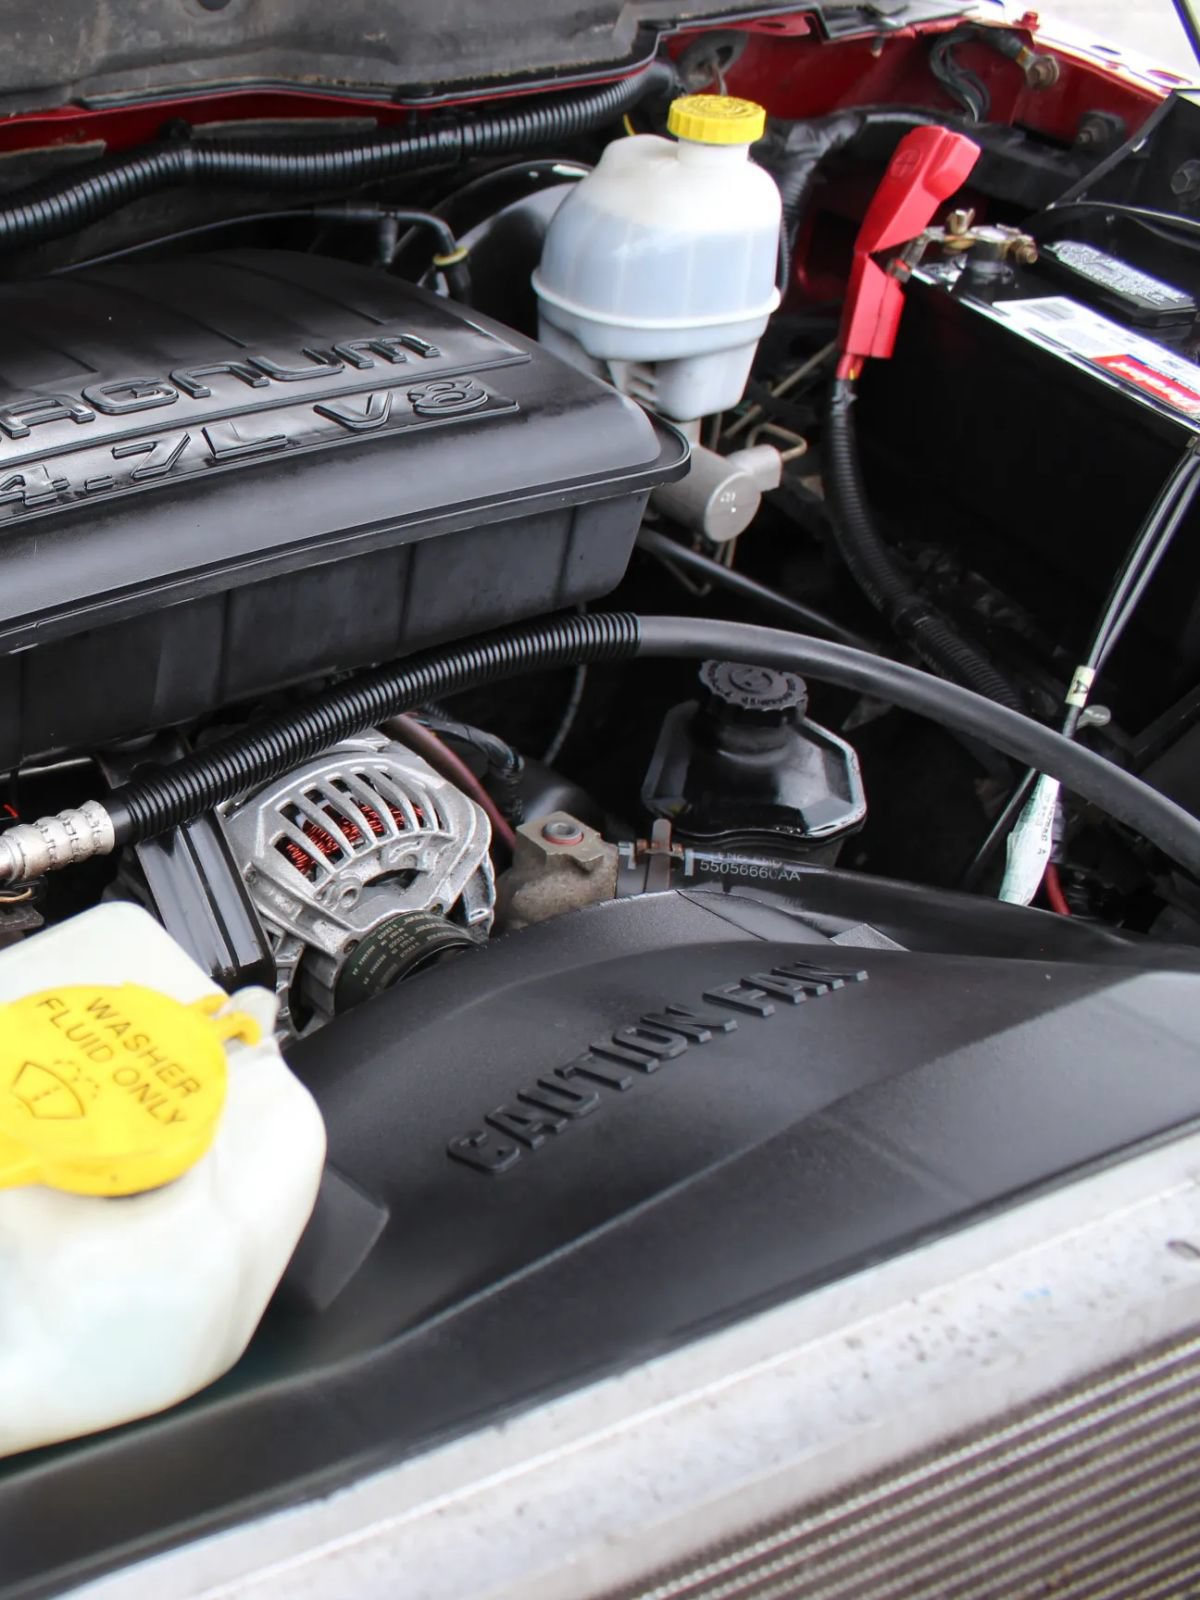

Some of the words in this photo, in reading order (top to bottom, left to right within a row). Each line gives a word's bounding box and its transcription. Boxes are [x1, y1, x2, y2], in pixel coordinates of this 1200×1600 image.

[313, 376, 490, 429] V8
[36, 997, 115, 1063] FLUID
[112, 1067, 187, 1126] ONLY
[86, 996, 202, 1099] WASHER
[446, 1004, 738, 1174] CAUTION
[702, 960, 869, 1018] FAN
